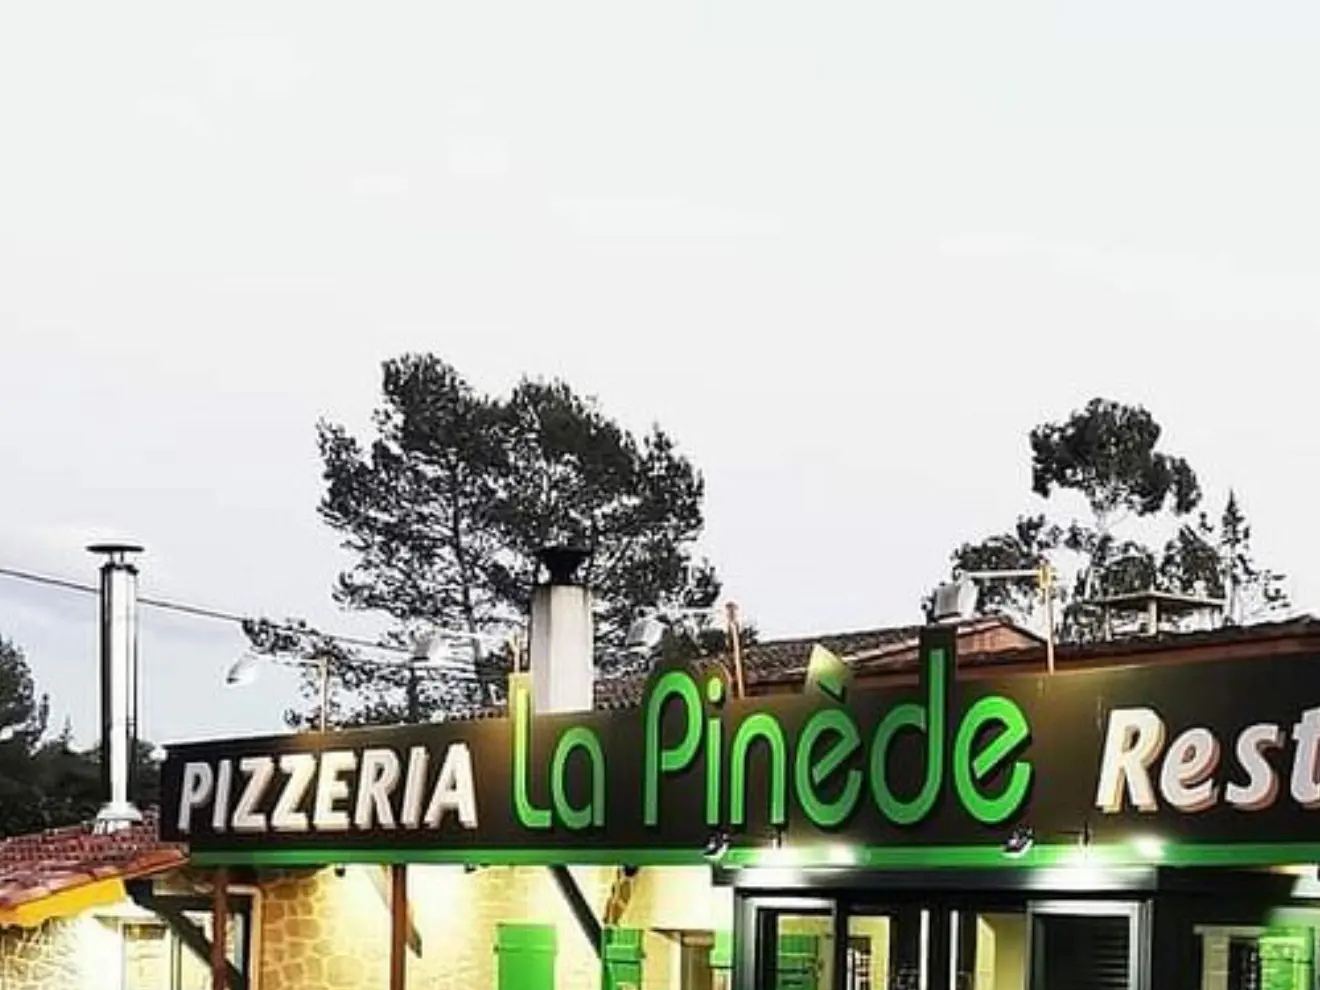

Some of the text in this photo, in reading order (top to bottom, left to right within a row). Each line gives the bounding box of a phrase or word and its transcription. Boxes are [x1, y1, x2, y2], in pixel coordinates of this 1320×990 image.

[177, 742, 479, 832] PIZZERIA
[512, 685, 603, 828] La
[645, 647, 1032, 826] Pinède
